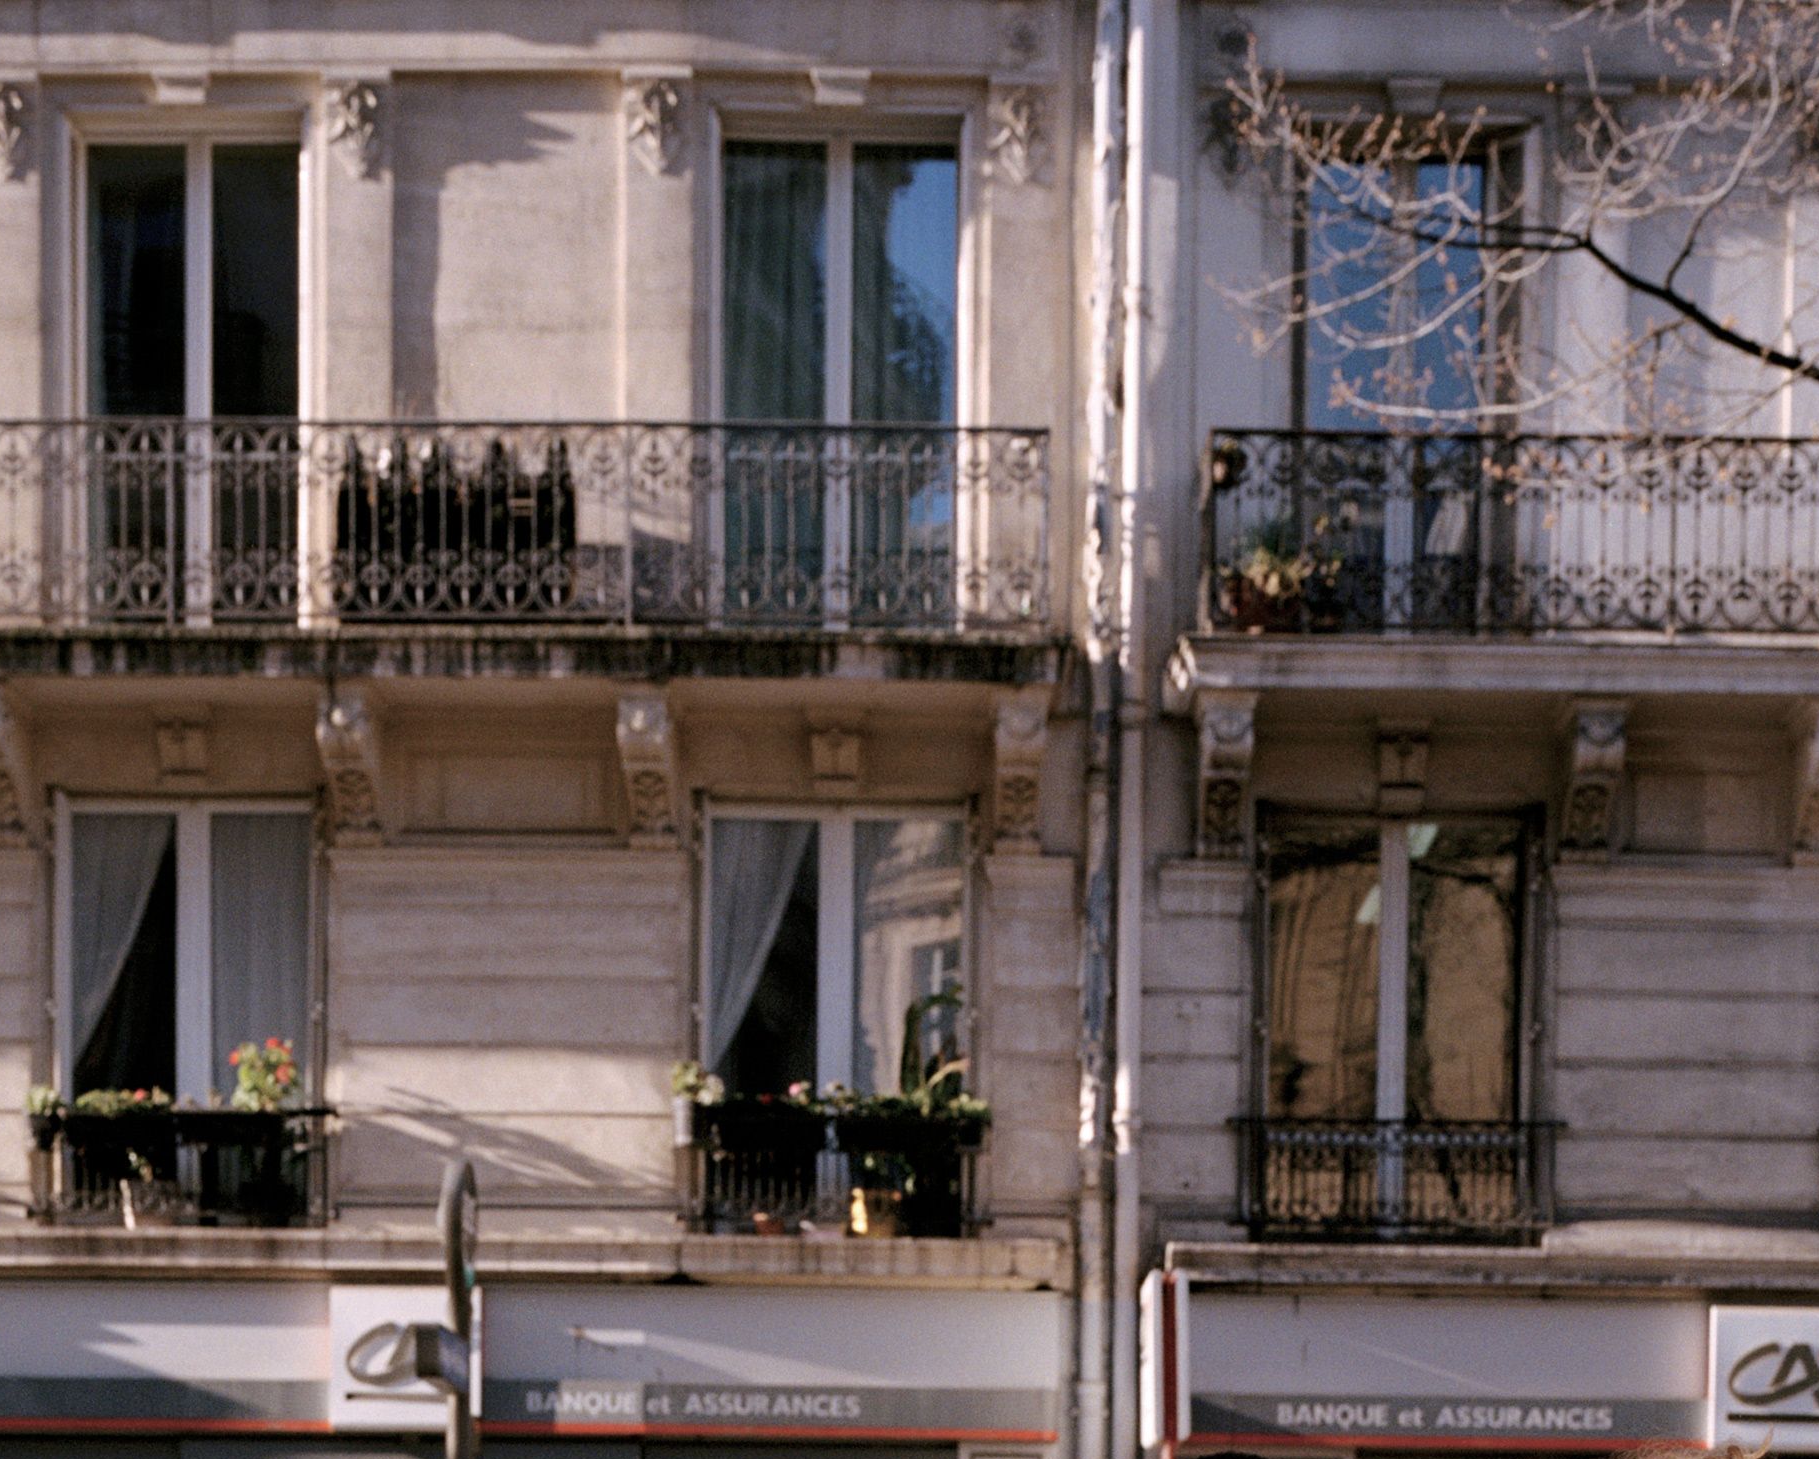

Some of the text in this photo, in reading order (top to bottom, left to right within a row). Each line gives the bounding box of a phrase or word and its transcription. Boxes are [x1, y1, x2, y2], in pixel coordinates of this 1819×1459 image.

[526, 1389, 862, 1419] BANQUE et ASSURANCES
[1276, 1402, 1614, 1432] BANQUE et ASSURANCES
